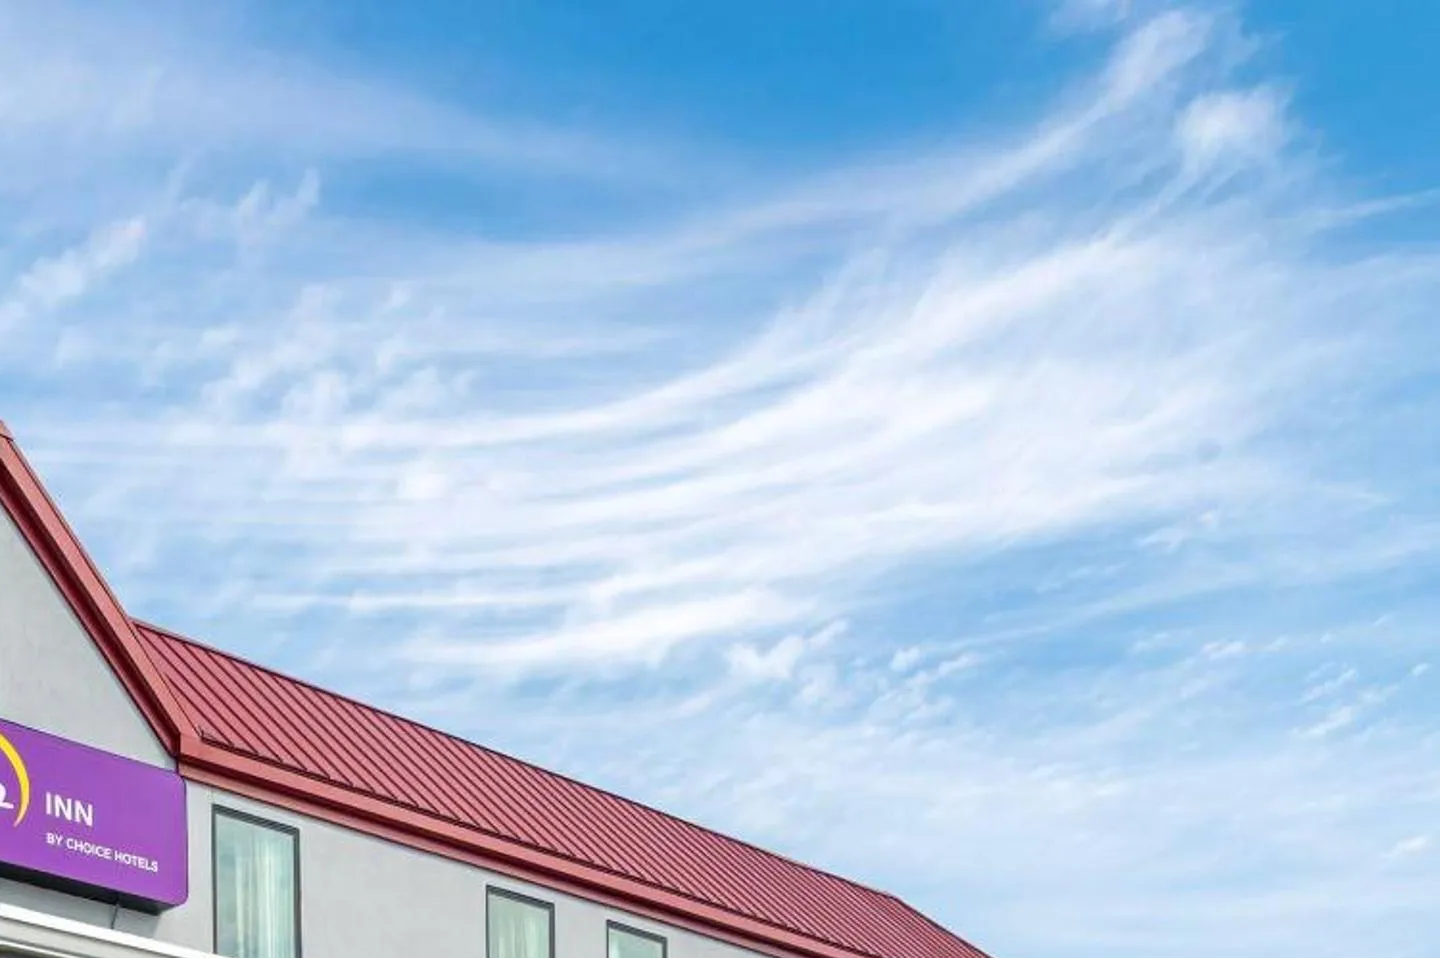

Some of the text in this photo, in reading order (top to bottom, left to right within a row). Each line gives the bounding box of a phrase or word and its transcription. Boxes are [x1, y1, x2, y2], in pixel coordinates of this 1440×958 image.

[45, 791, 94, 827] INN
[46, 832, 159, 873] BY CHOICE HOTELS
